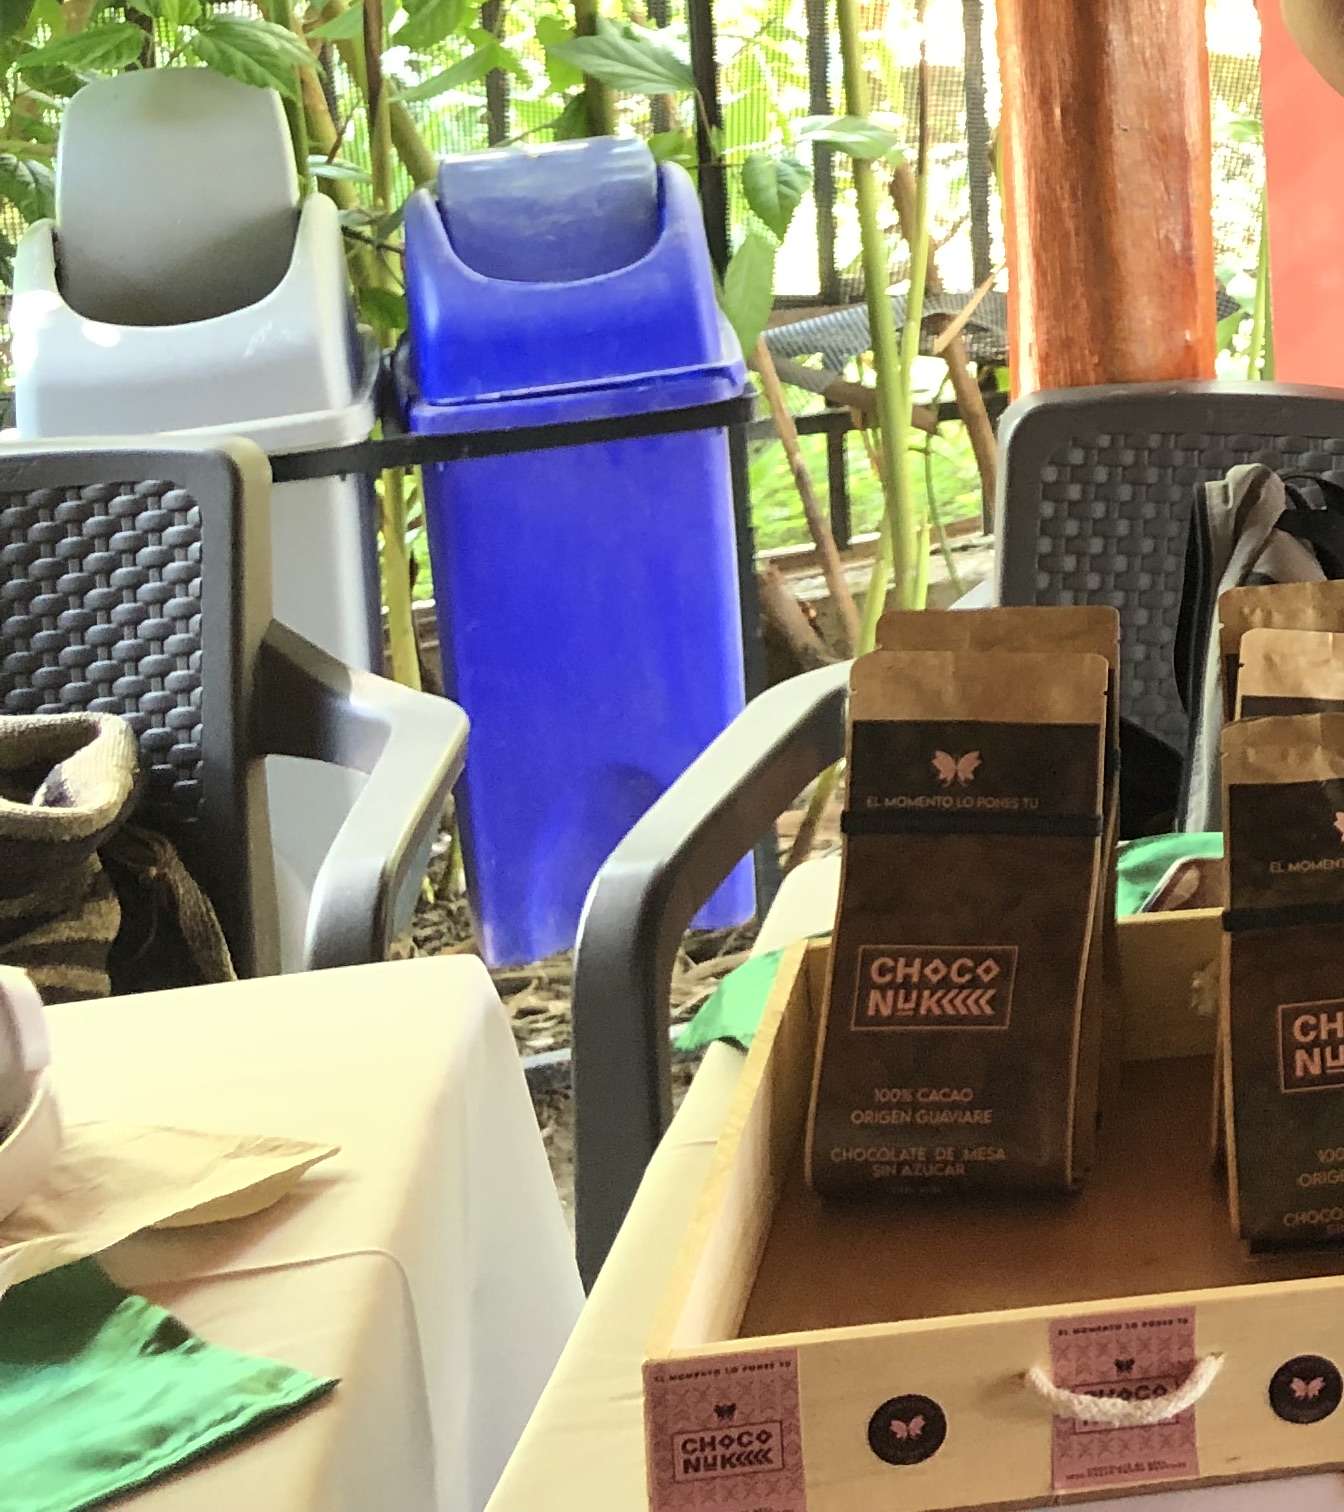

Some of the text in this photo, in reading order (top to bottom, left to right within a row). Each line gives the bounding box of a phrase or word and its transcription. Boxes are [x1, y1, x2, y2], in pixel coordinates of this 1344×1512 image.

[884, 795, 954, 809] MOMENTO
[956, 796, 975, 809] LO
[870, 957, 1000, 985] CHOCO
[681, 1429, 773, 1455] CHOCO
